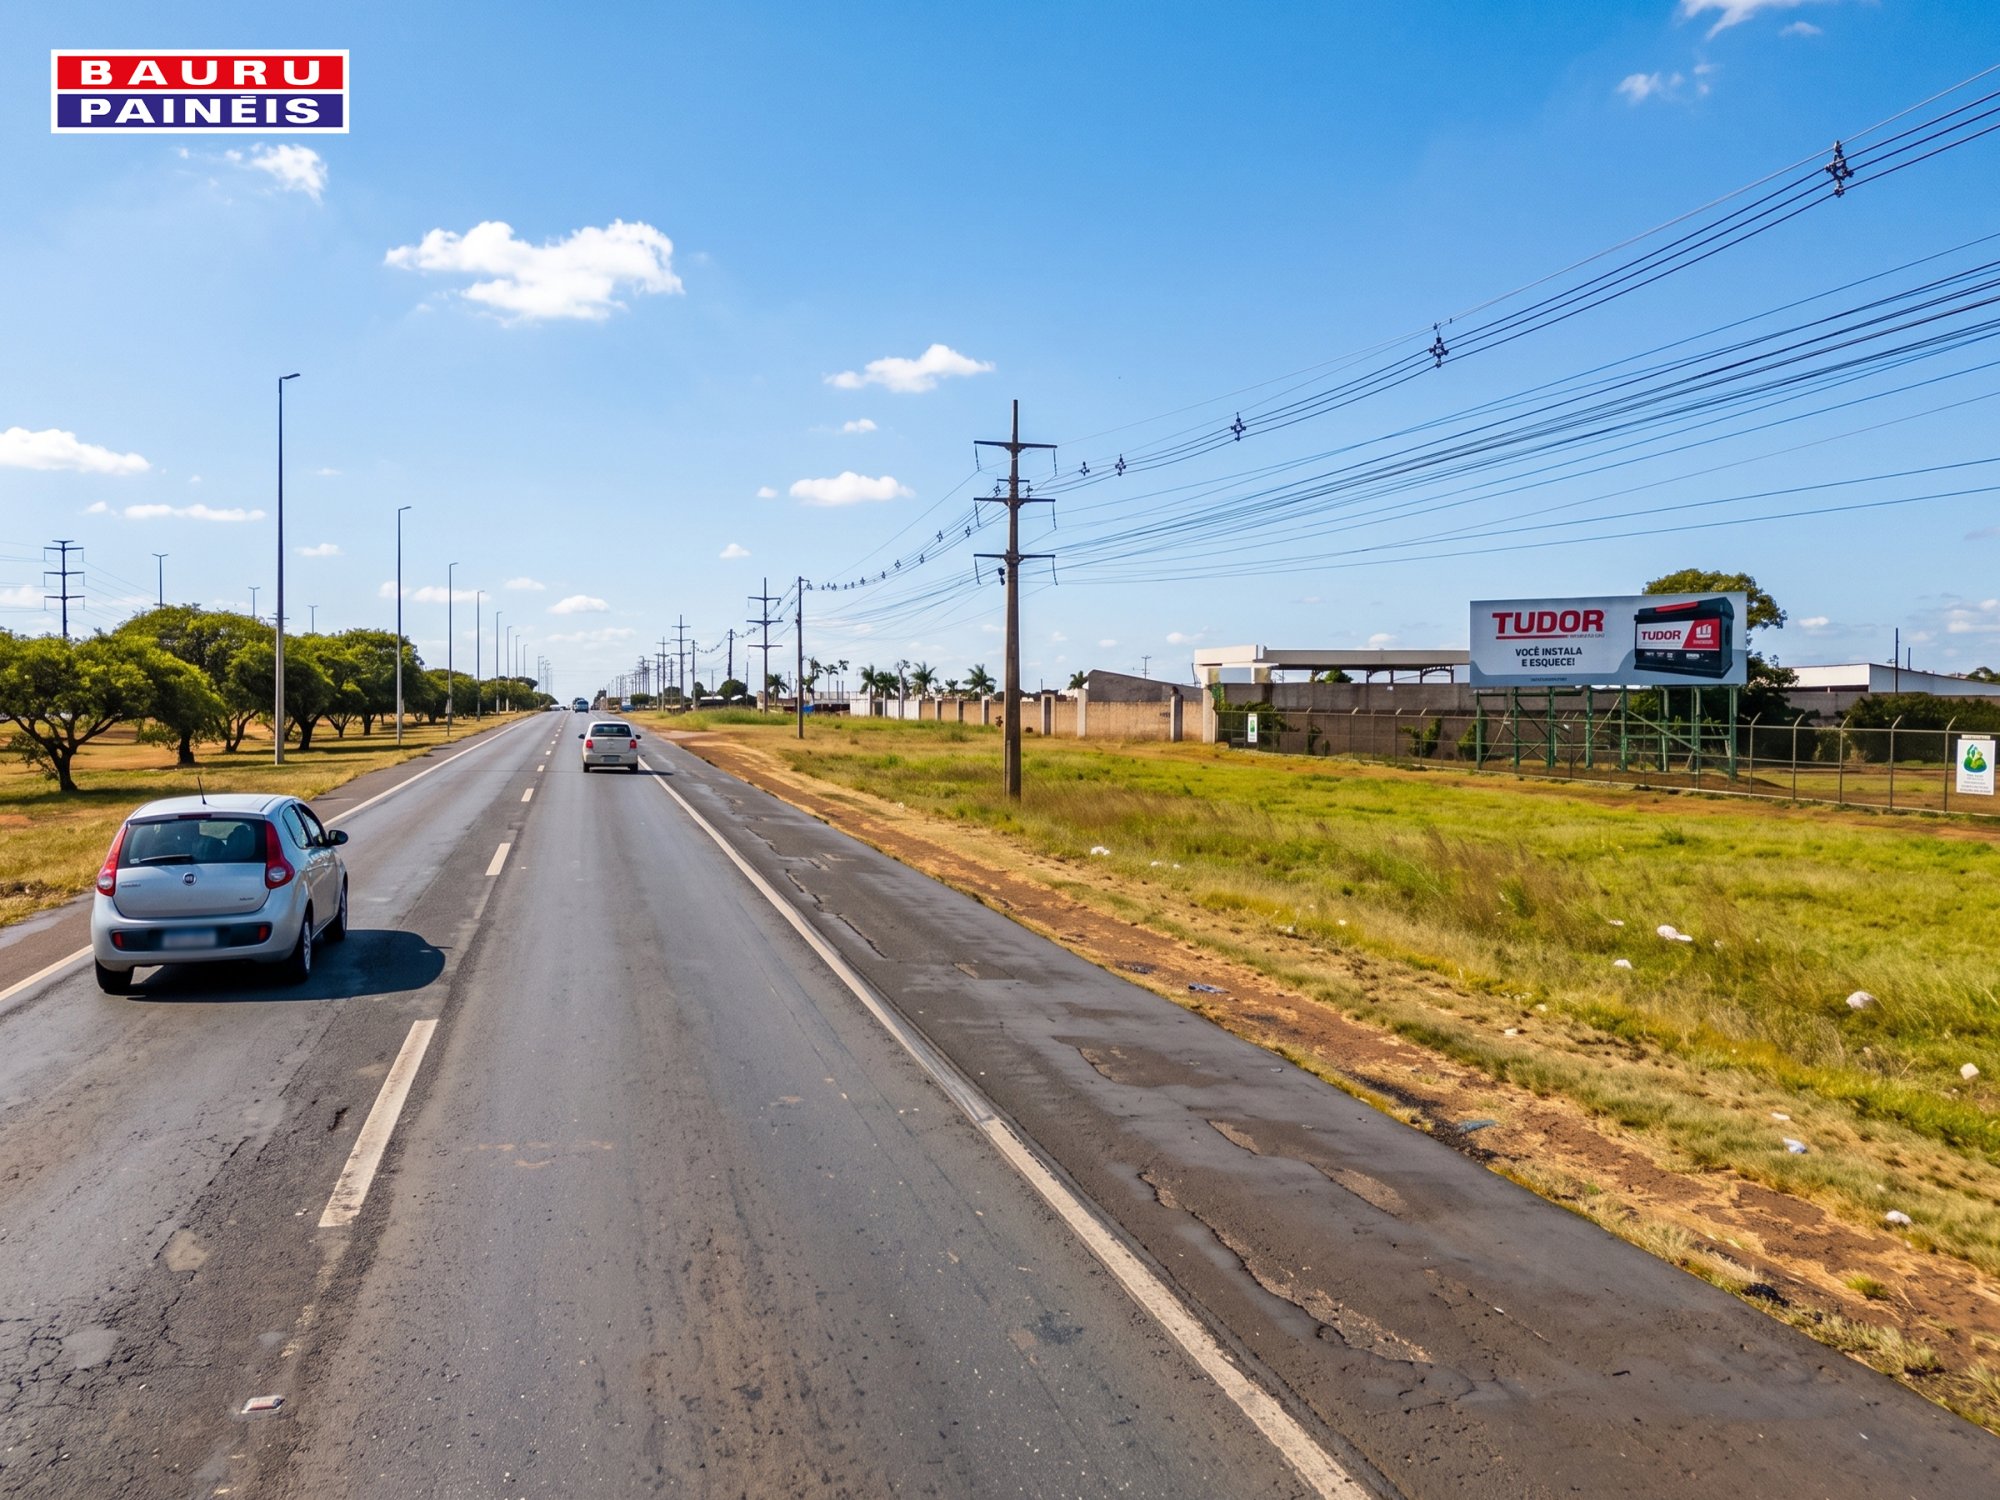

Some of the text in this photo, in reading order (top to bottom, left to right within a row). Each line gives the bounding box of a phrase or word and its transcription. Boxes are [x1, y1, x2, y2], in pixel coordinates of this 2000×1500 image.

[1492, 609, 1605, 634] TUDOR
[1641, 630, 1682, 640] TUDOR
[1515, 646, 1583, 657] VOCÊ INSTALA
[1521, 657, 1576, 668] E ESQUECE!
